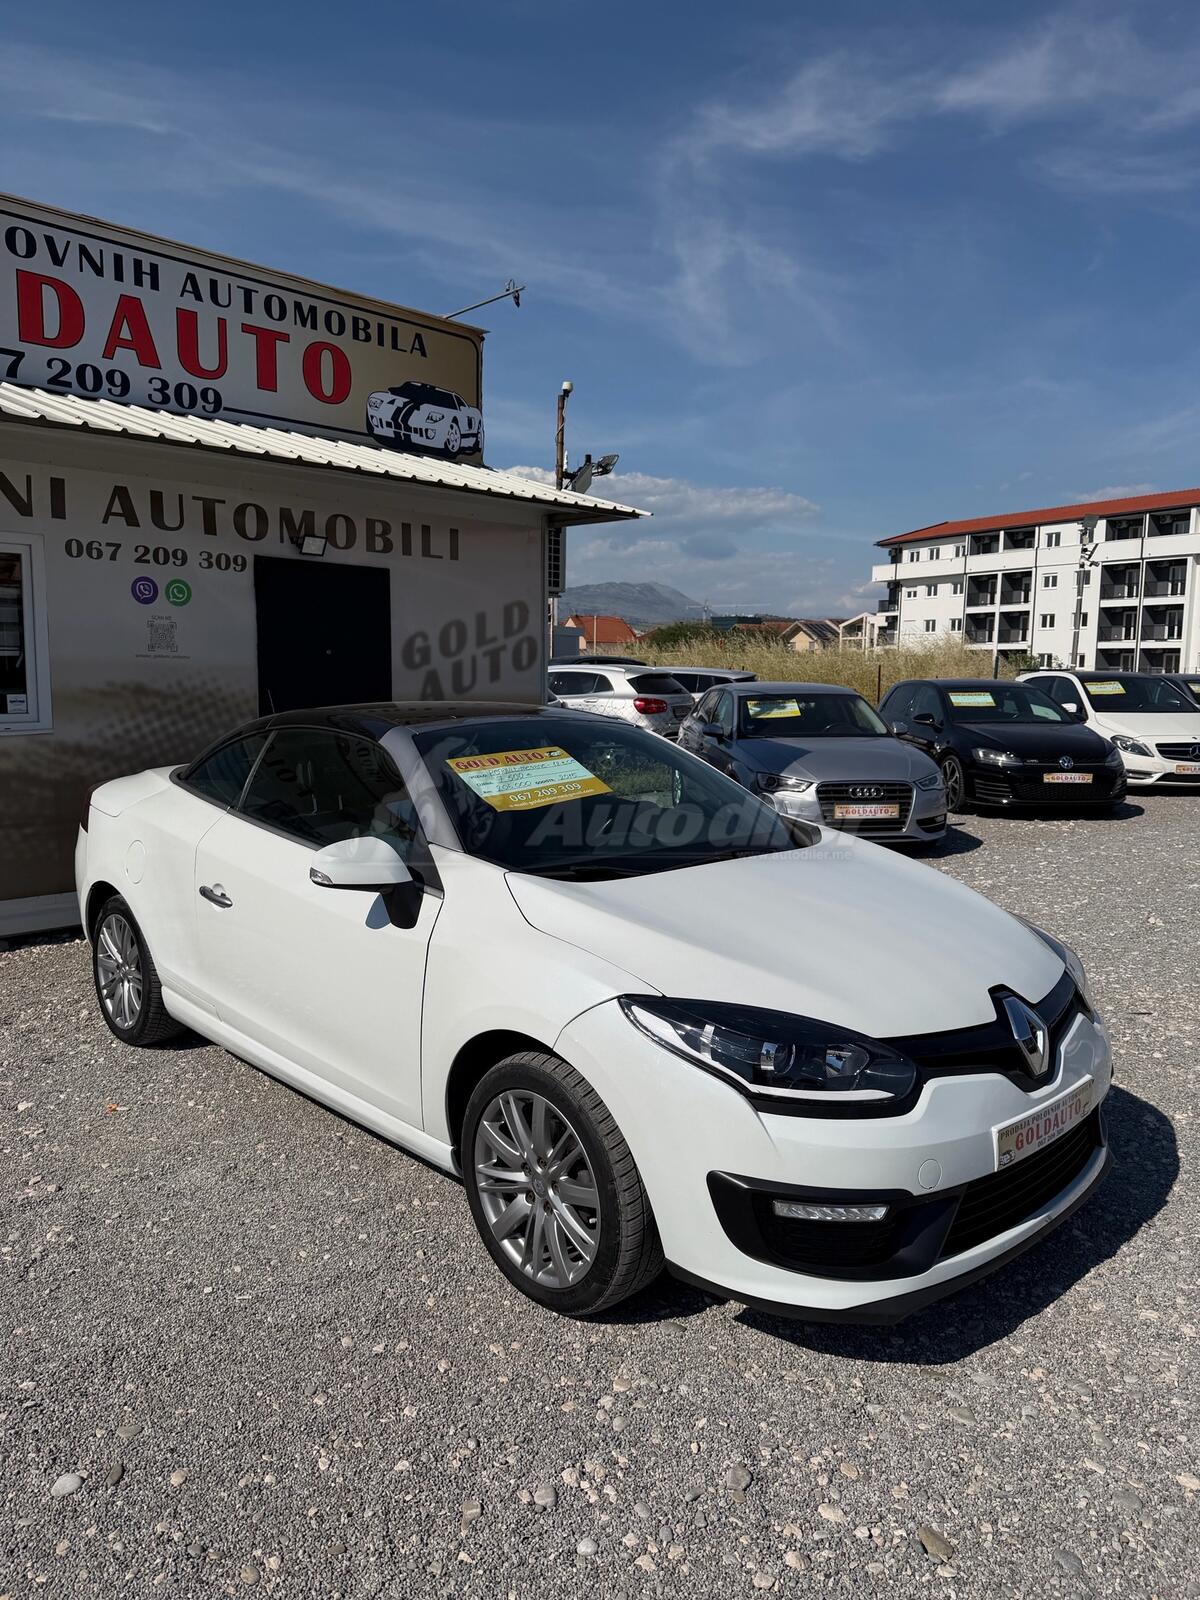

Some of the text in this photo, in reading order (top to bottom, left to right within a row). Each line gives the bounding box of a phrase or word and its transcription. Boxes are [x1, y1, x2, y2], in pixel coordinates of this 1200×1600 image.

[5, 226, 430, 358] OVNIH AUTOMOBILA
[16, 268, 352, 405] DAUTO
[46, 357, 131, 397] 209
[147, 377, 224, 414] 309
[102, 485, 460, 561] AUTOMOBILI
[65, 538, 249, 573] 067 209 309
[401, 599, 529, 671] GOLD
[420, 635, 538, 702] AUTO
[455, 758, 500, 771] GOLD
[504, 751, 545, 764] AUTO
[509, 793, 531, 802] 067
[535, 788, 557, 798] 209
[558, 782, 582, 792] 309
[846, 808, 889, 816] GOLDAUTO
[1015, 1098, 1081, 1151] GOLDAUTO
